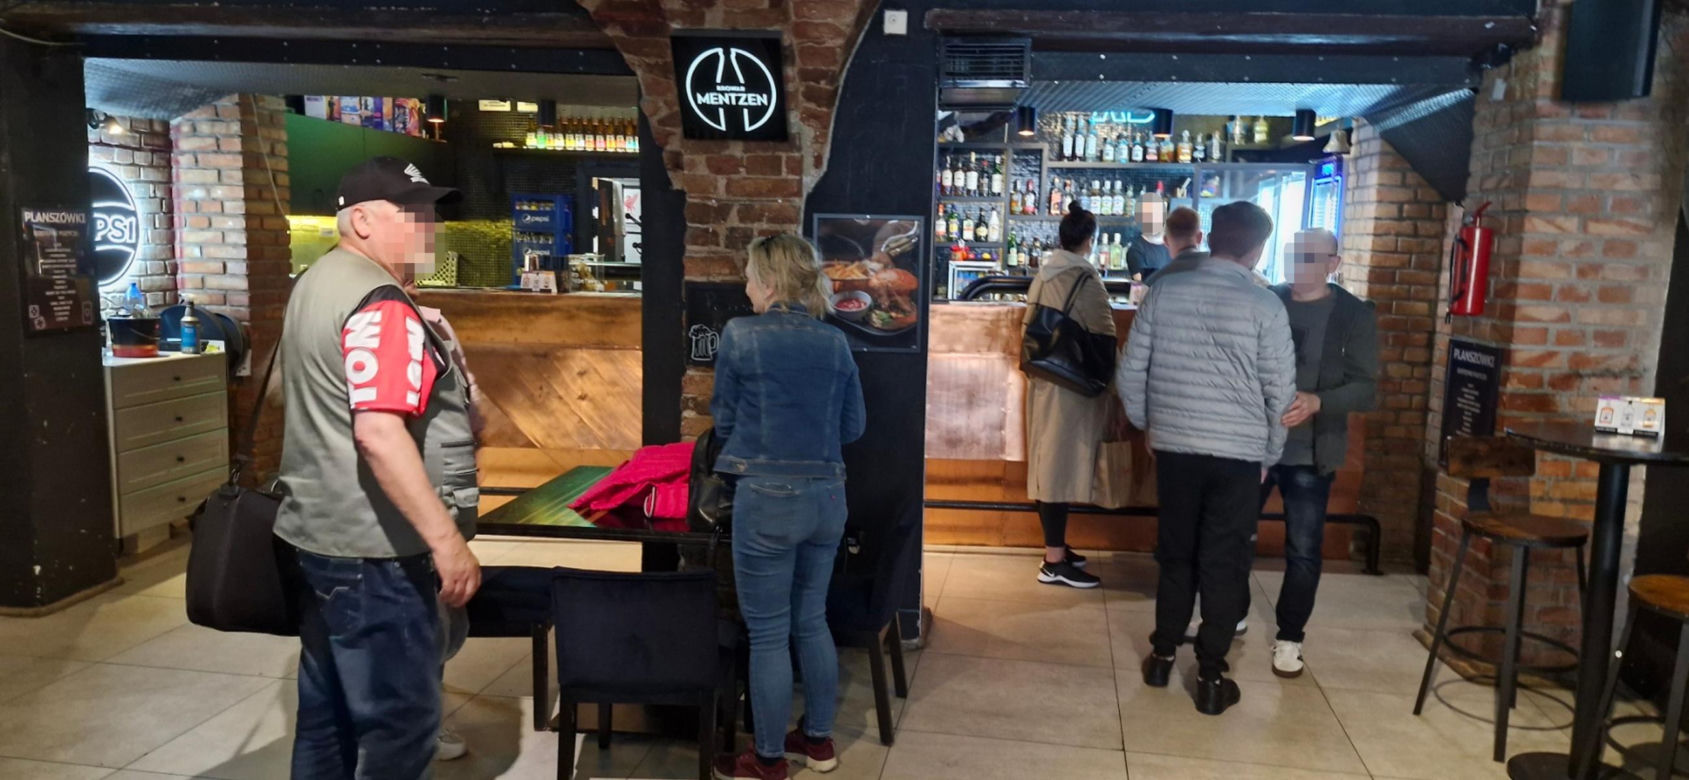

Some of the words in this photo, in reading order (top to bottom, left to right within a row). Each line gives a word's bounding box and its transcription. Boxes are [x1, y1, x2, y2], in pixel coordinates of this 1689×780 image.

[696, 92, 768, 106] MENTZEN
[24, 211, 86, 223] PLANSZÓWKI
[93, 212, 137, 243] PSI
